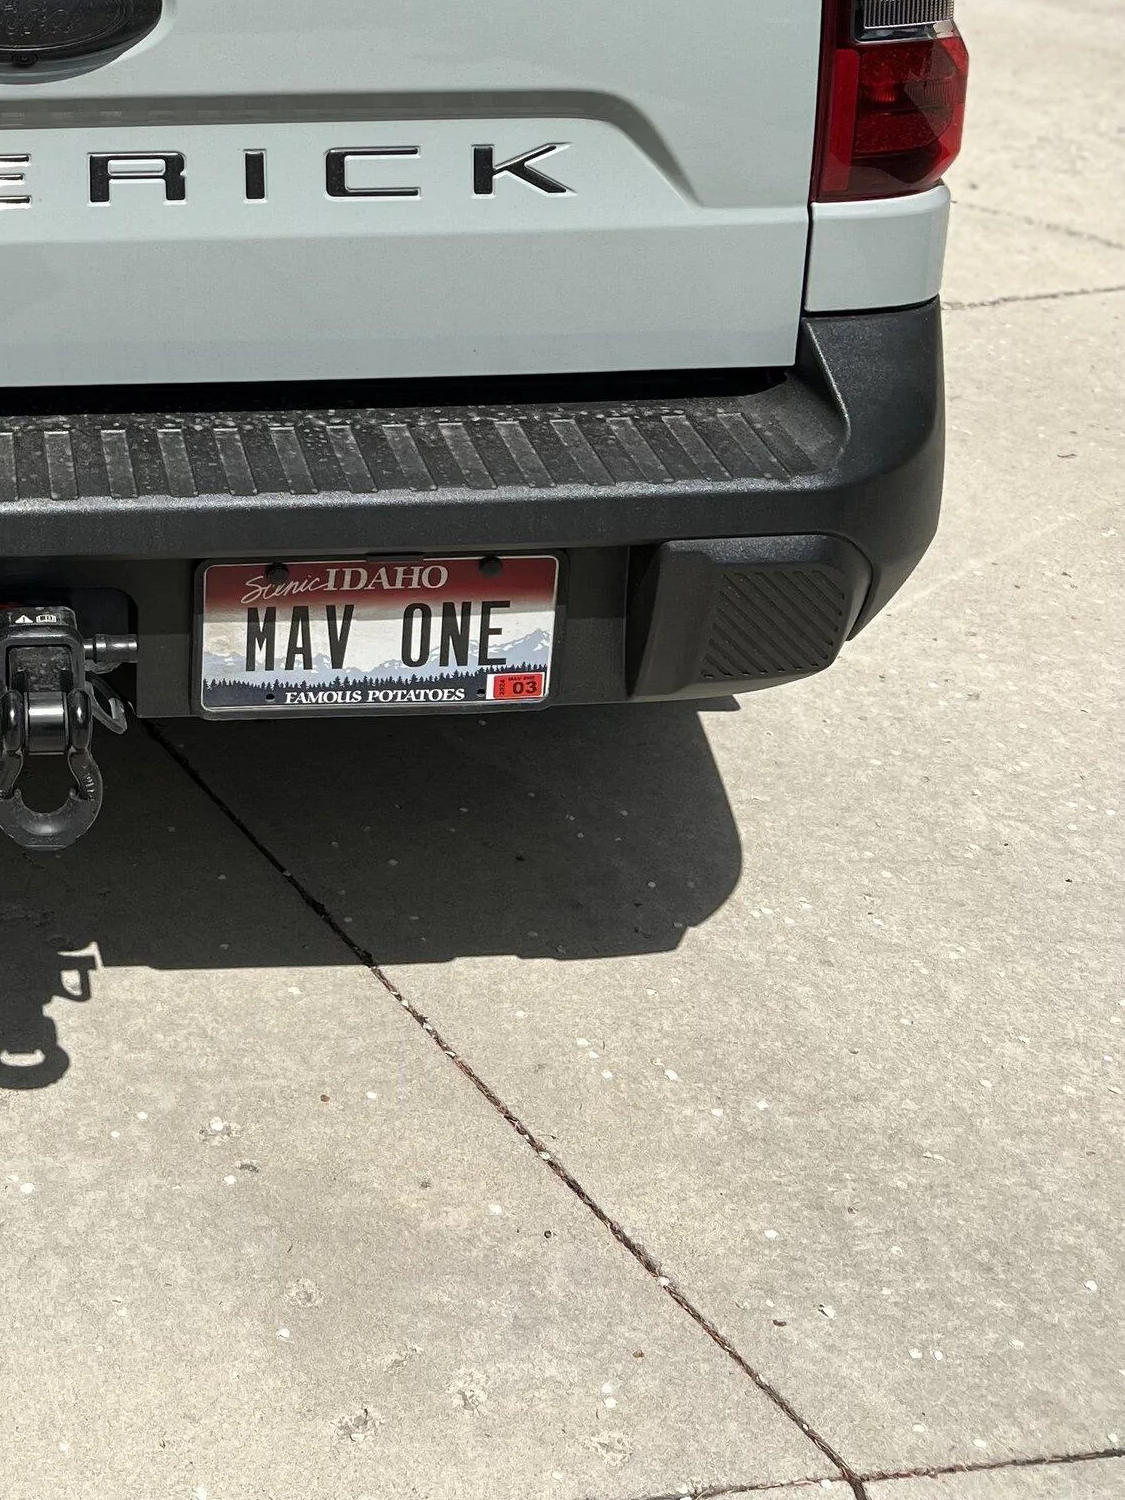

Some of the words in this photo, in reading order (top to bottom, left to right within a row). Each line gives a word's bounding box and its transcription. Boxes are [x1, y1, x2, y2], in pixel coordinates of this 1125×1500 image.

[241, 574, 327, 604] Scenic
[323, 565, 449, 591] IDAHO
[246, 604, 354, 672] MAV
[401, 600, 511, 667] ONE
[285, 690, 362, 704] FAMOUS
[366, 688, 465, 702] POTATOES
[512, 681, 538, 695] 03
